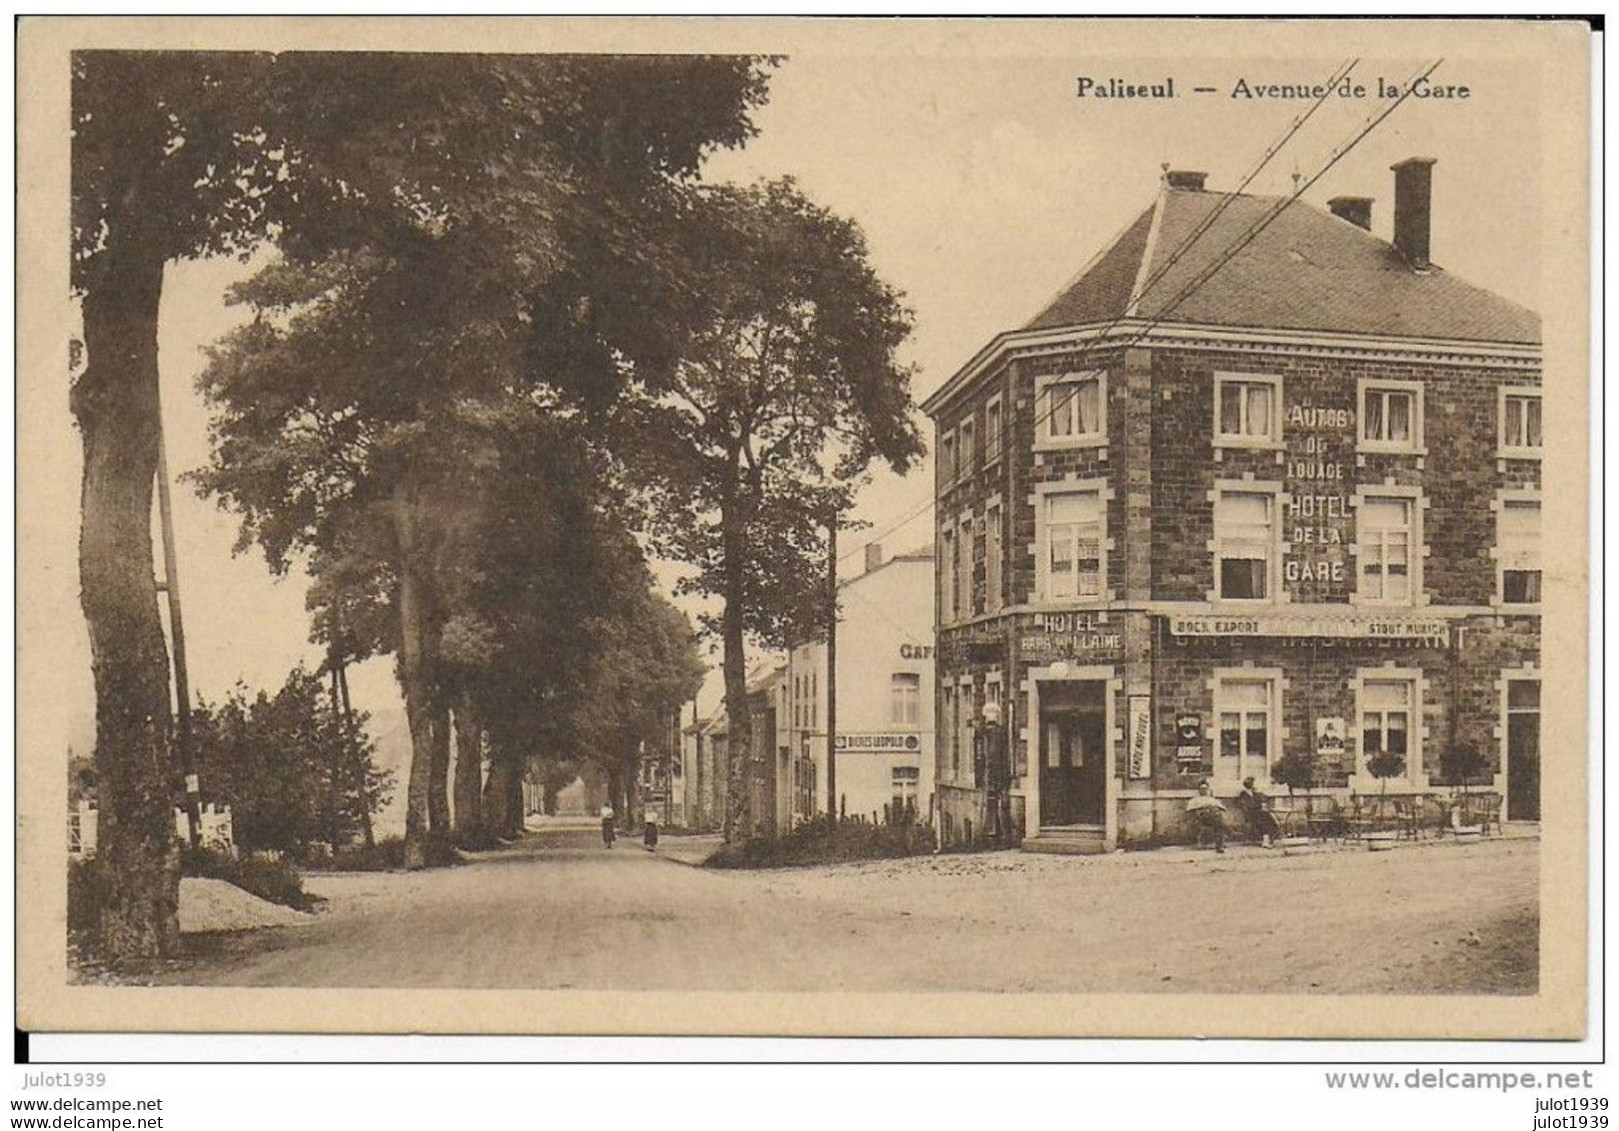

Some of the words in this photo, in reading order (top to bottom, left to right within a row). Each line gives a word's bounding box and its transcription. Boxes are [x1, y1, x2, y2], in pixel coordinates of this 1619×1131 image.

[1295, 528, 1313, 543] DE
[1320, 528, 1341, 544] LA
[1286, 561, 1344, 581] GARE
[1045, 613, 1096, 632] HOTEL
[1177, 621, 1210, 633] BOCK
[1215, 621, 1259, 633] EXPORT
[1368, 623, 1400, 635] STOUT
[1405, 623, 1446, 635] MUNICH
